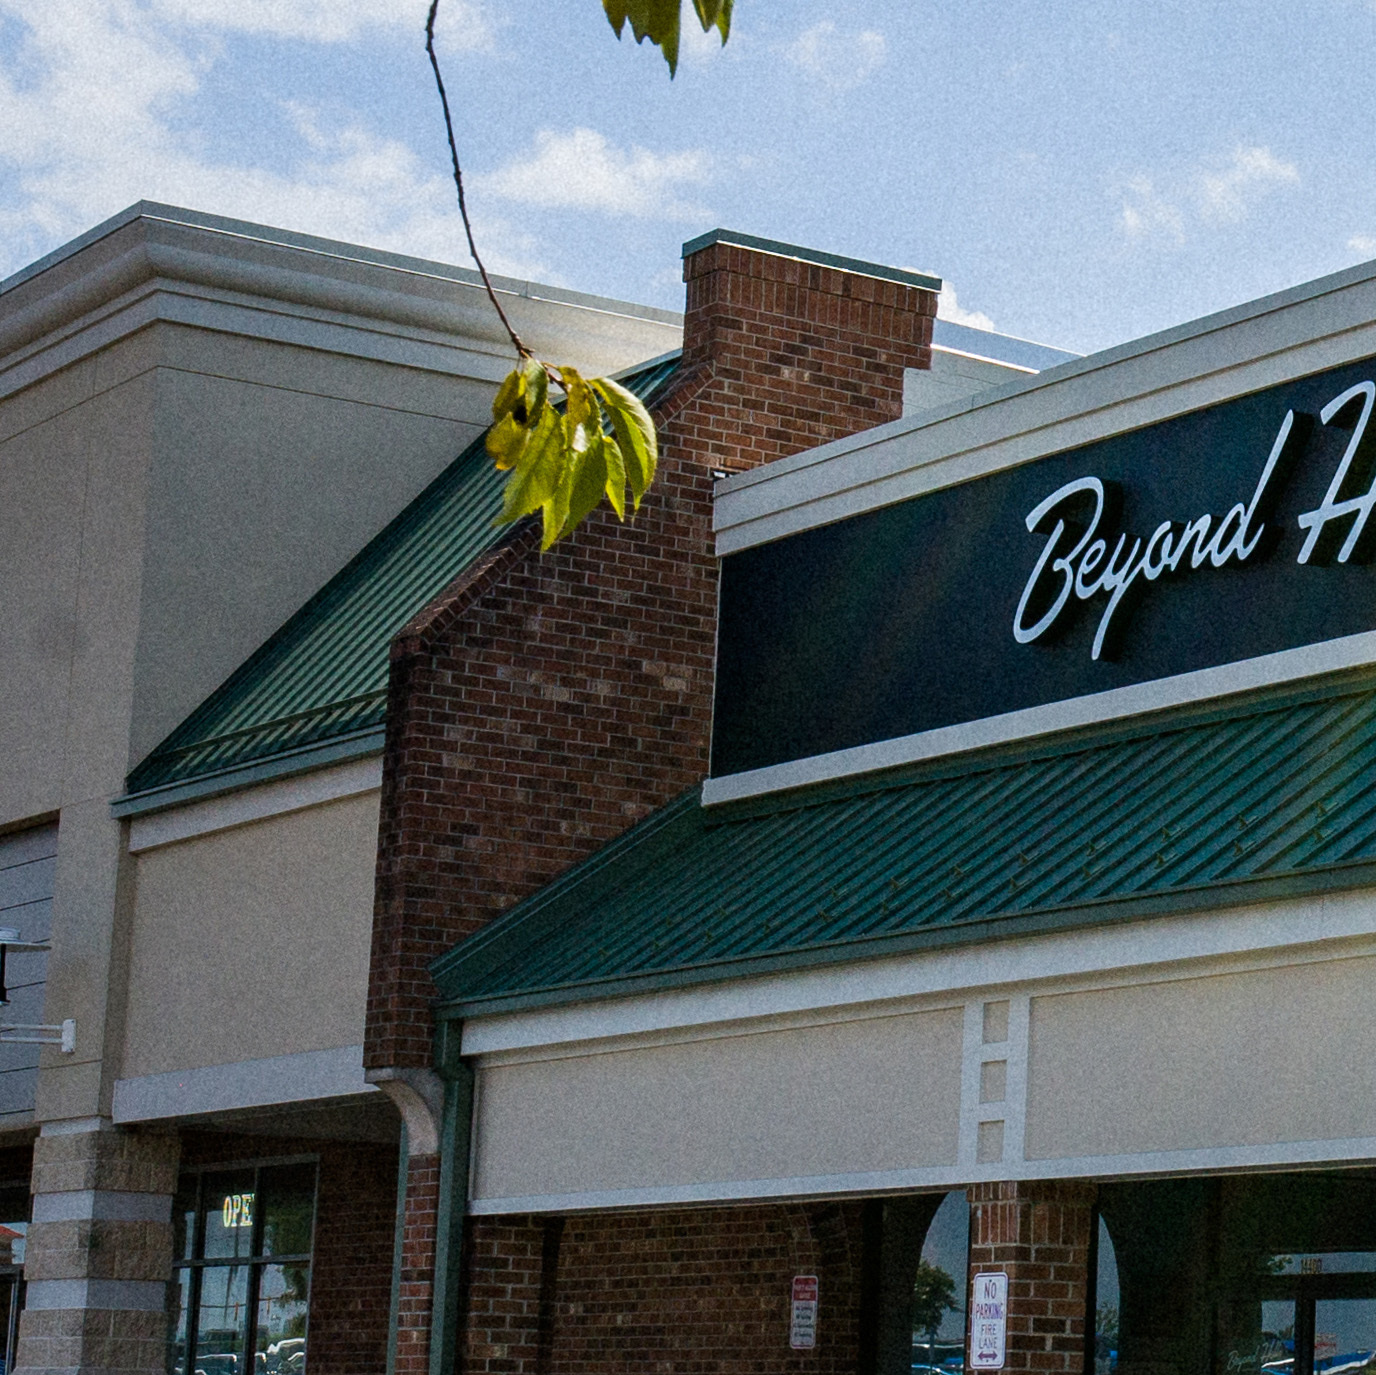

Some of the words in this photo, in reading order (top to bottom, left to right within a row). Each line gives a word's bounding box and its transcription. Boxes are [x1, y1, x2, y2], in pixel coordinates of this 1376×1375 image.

[1012, 408, 1295, 661] Beyond
[223, 1193, 255, 1227] OPE
[983, 1281, 997, 1299] NO
[975, 1302, 1004, 1320] PARKING
[980, 1323, 997, 1336] FIRE
[978, 1337, 998, 1350] LANE
